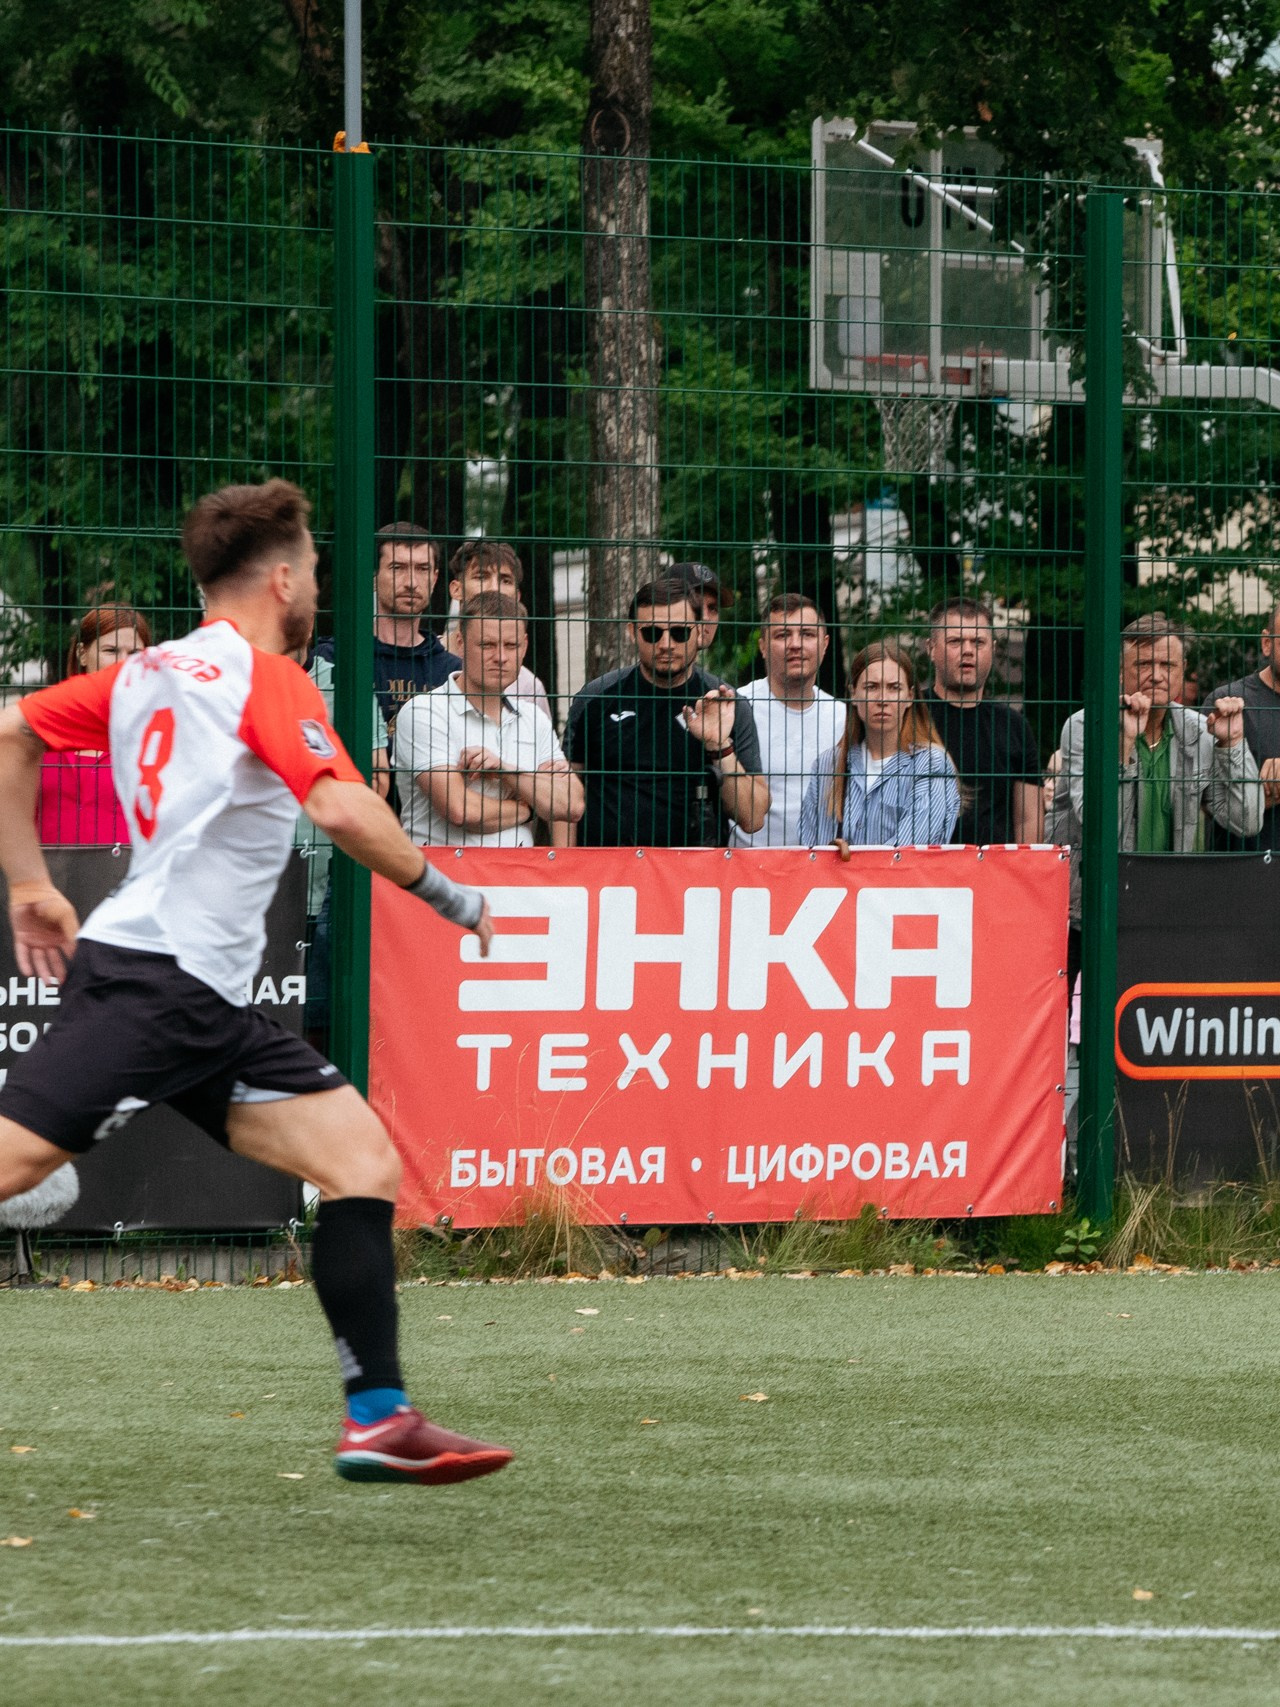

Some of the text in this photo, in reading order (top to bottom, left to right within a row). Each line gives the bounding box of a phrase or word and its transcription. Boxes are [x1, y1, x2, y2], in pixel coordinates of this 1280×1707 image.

[134, 708, 175, 841] 8
[458, 885, 974, 1012] ЭНКА
[456, 1029, 971, 1092] ТЕХНИКА
[450, 1140, 969, 1190] БЫТОВАЯ ЦИФРОВАЯ
